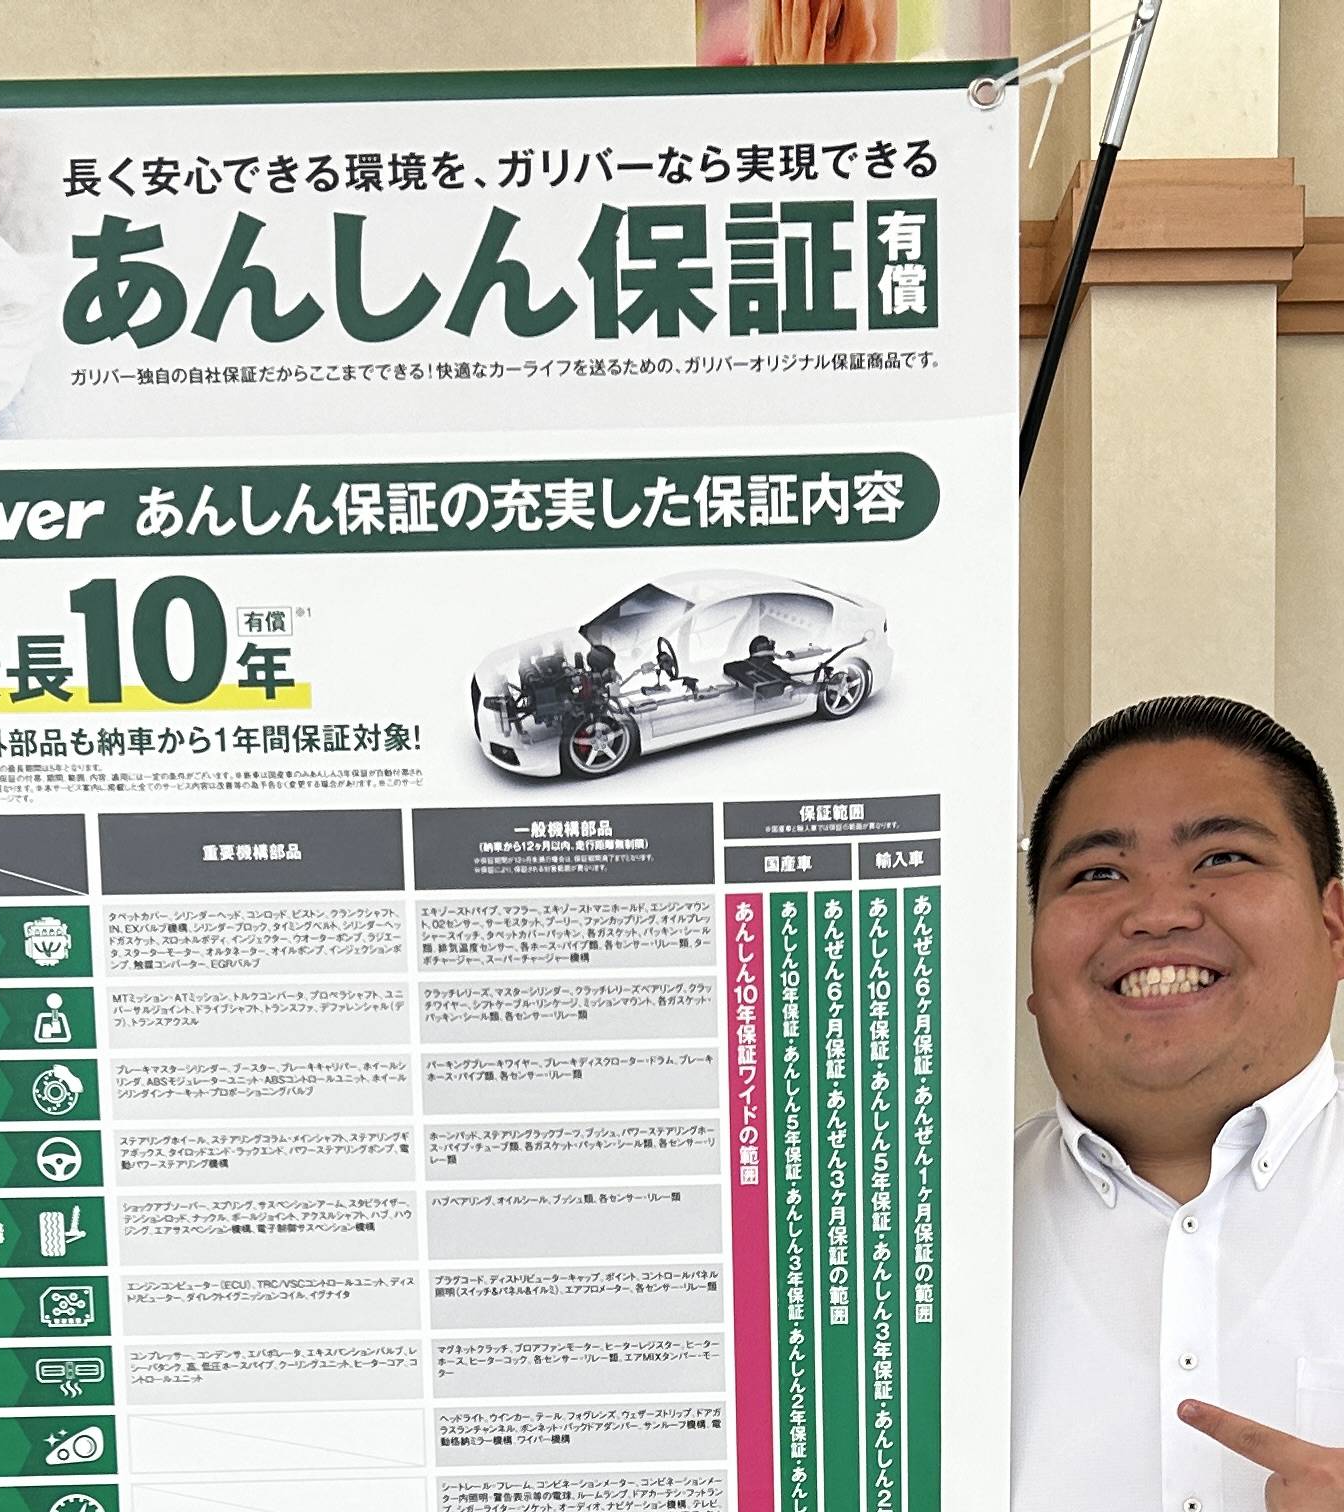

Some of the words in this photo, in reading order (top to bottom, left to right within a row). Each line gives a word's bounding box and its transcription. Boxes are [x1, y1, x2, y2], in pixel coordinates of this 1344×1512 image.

[63, 140, 938, 197] 長く安心できる環境を、ガリバーなら実現できる
[63, 201, 857, 350] あんしん保証
[136, 471, 905, 537] あんしん保証の充実した保証内容
[799, 803, 865, 822] 保証範囲
[514, 820, 613, 838] 一般機構部品
[202, 843, 302, 862] 重要機構部品
[875, 850, 924, 869] 輸入車
[764, 855, 813, 873] 国産車
